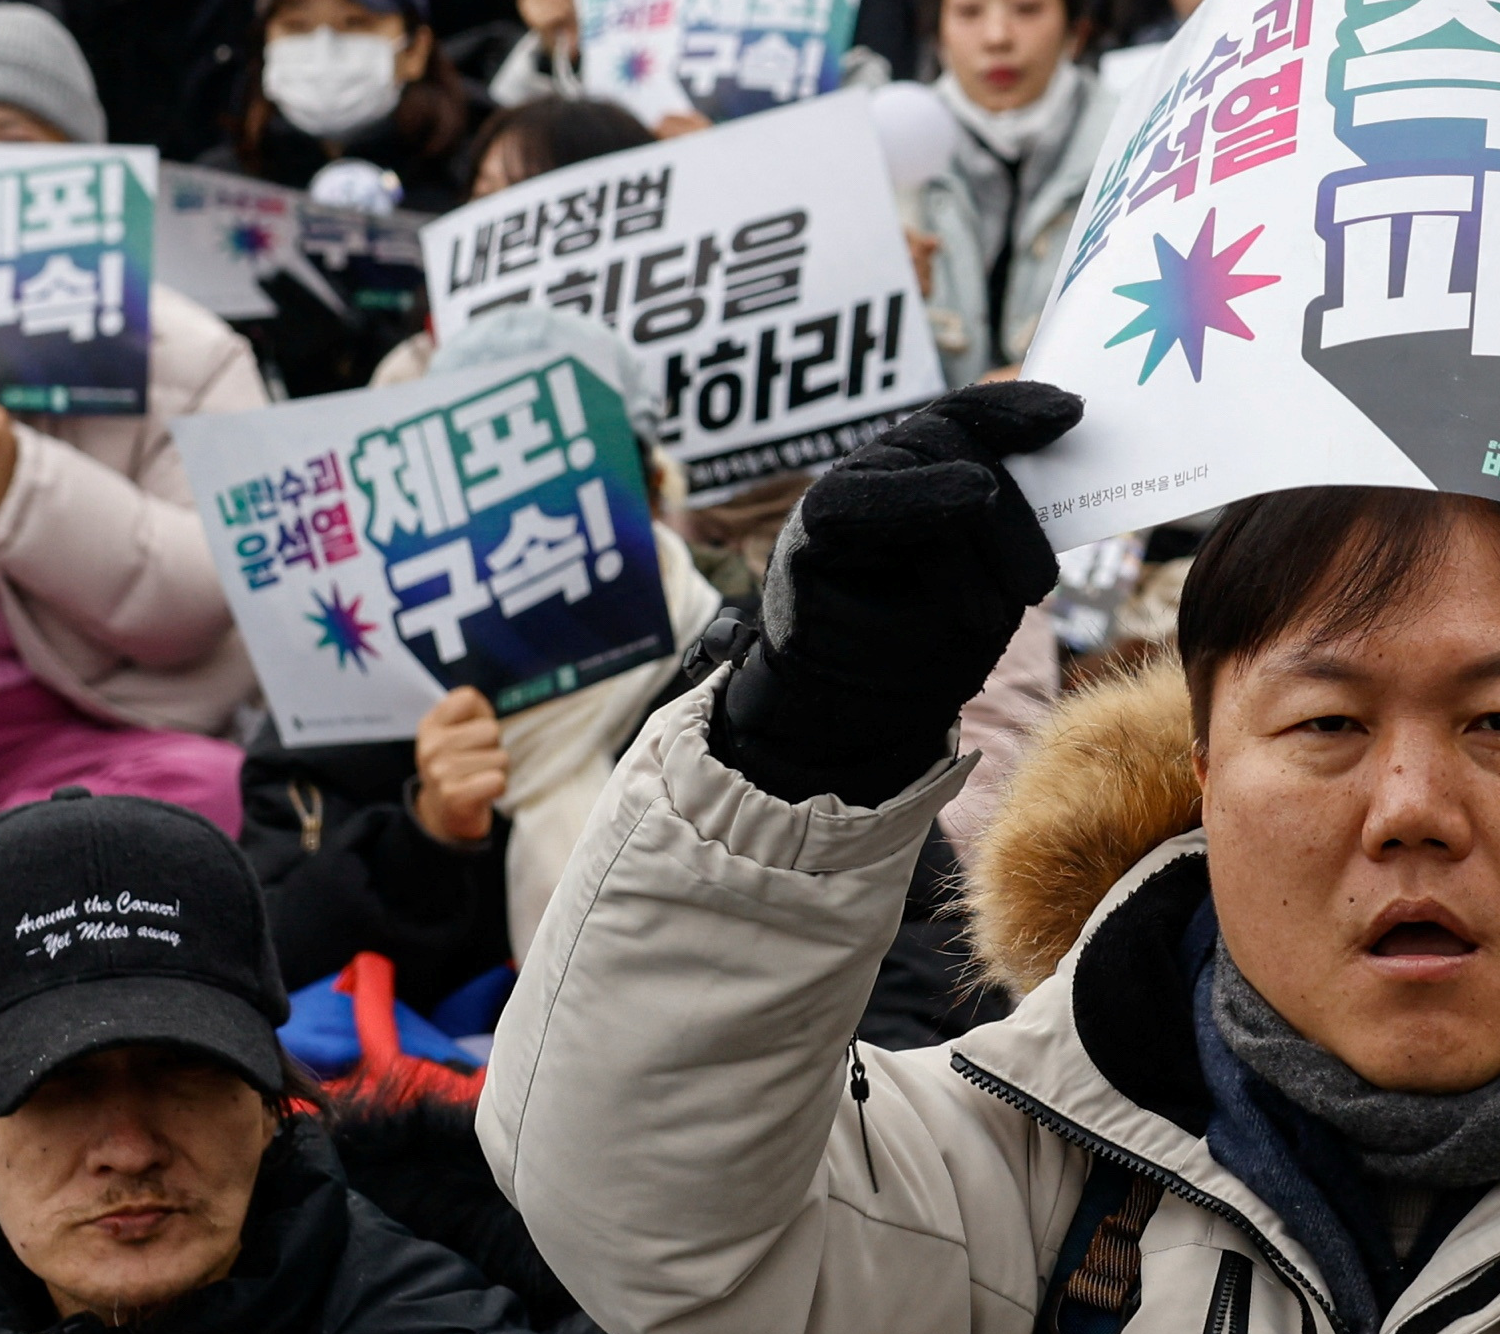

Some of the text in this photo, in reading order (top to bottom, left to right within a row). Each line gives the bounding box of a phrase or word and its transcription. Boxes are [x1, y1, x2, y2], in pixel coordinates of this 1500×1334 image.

[677, 32, 825, 99] 구속!
[1055, 59, 1303, 302] 윤석열
[449, 165, 675, 300] 내란정범
[216, 450, 344, 529] 내란수괴
[353, 364, 599, 550] 체포!
[1052, 499, 1076, 519] 참사'
[1078, 484, 1127, 509] 희생자의
[1131, 475, 1170, 497] 명복을
[1174, 463, 1209, 487] 빕니다
[237, 500, 361, 593] 윤석열
[388, 481, 626, 666] 구속!
[76, 920, 130, 941] Miles
[136, 924, 182, 948] away
[83, 894, 113, 915] the
